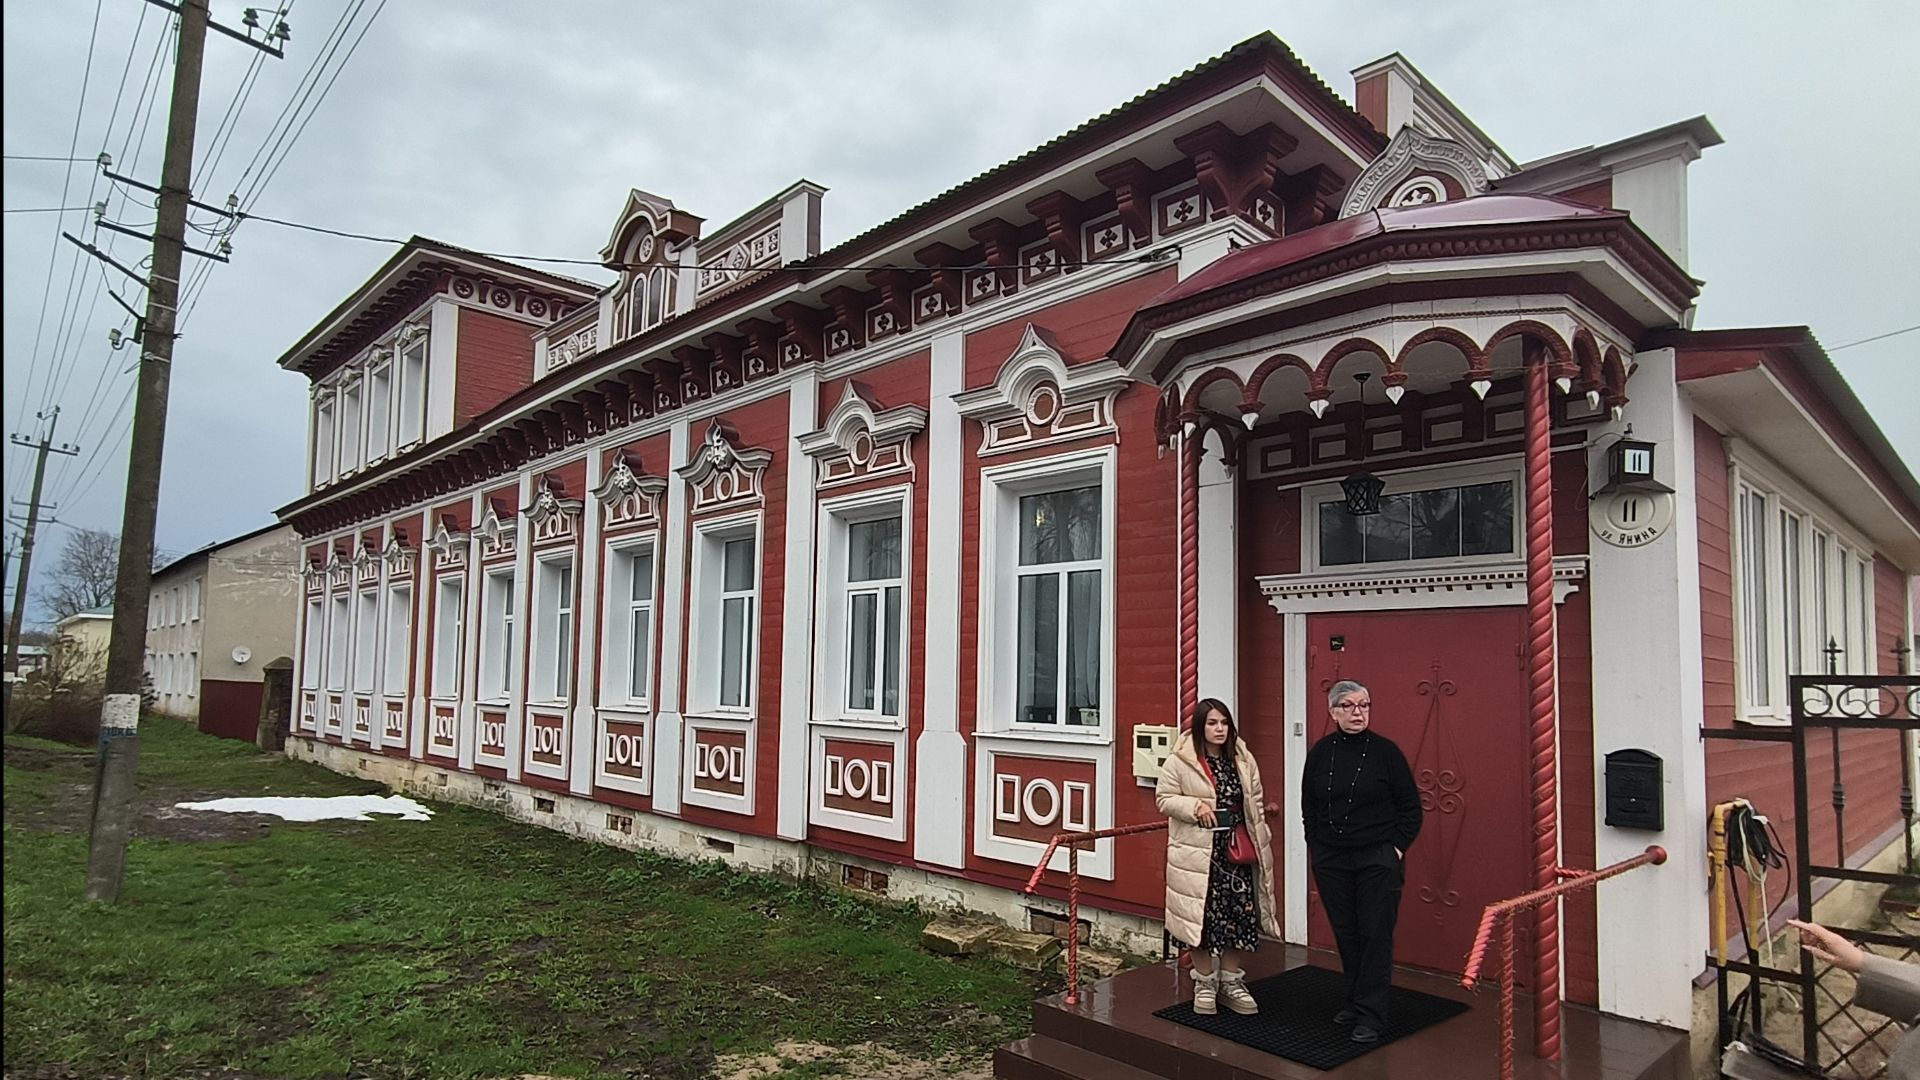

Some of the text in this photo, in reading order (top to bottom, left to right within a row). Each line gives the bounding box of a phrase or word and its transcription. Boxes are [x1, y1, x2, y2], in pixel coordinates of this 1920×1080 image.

[1633, 452, 1642, 472] 11
[1623, 498, 1637, 522] 11
[1618, 526, 1657, 544] ЯНИНА
